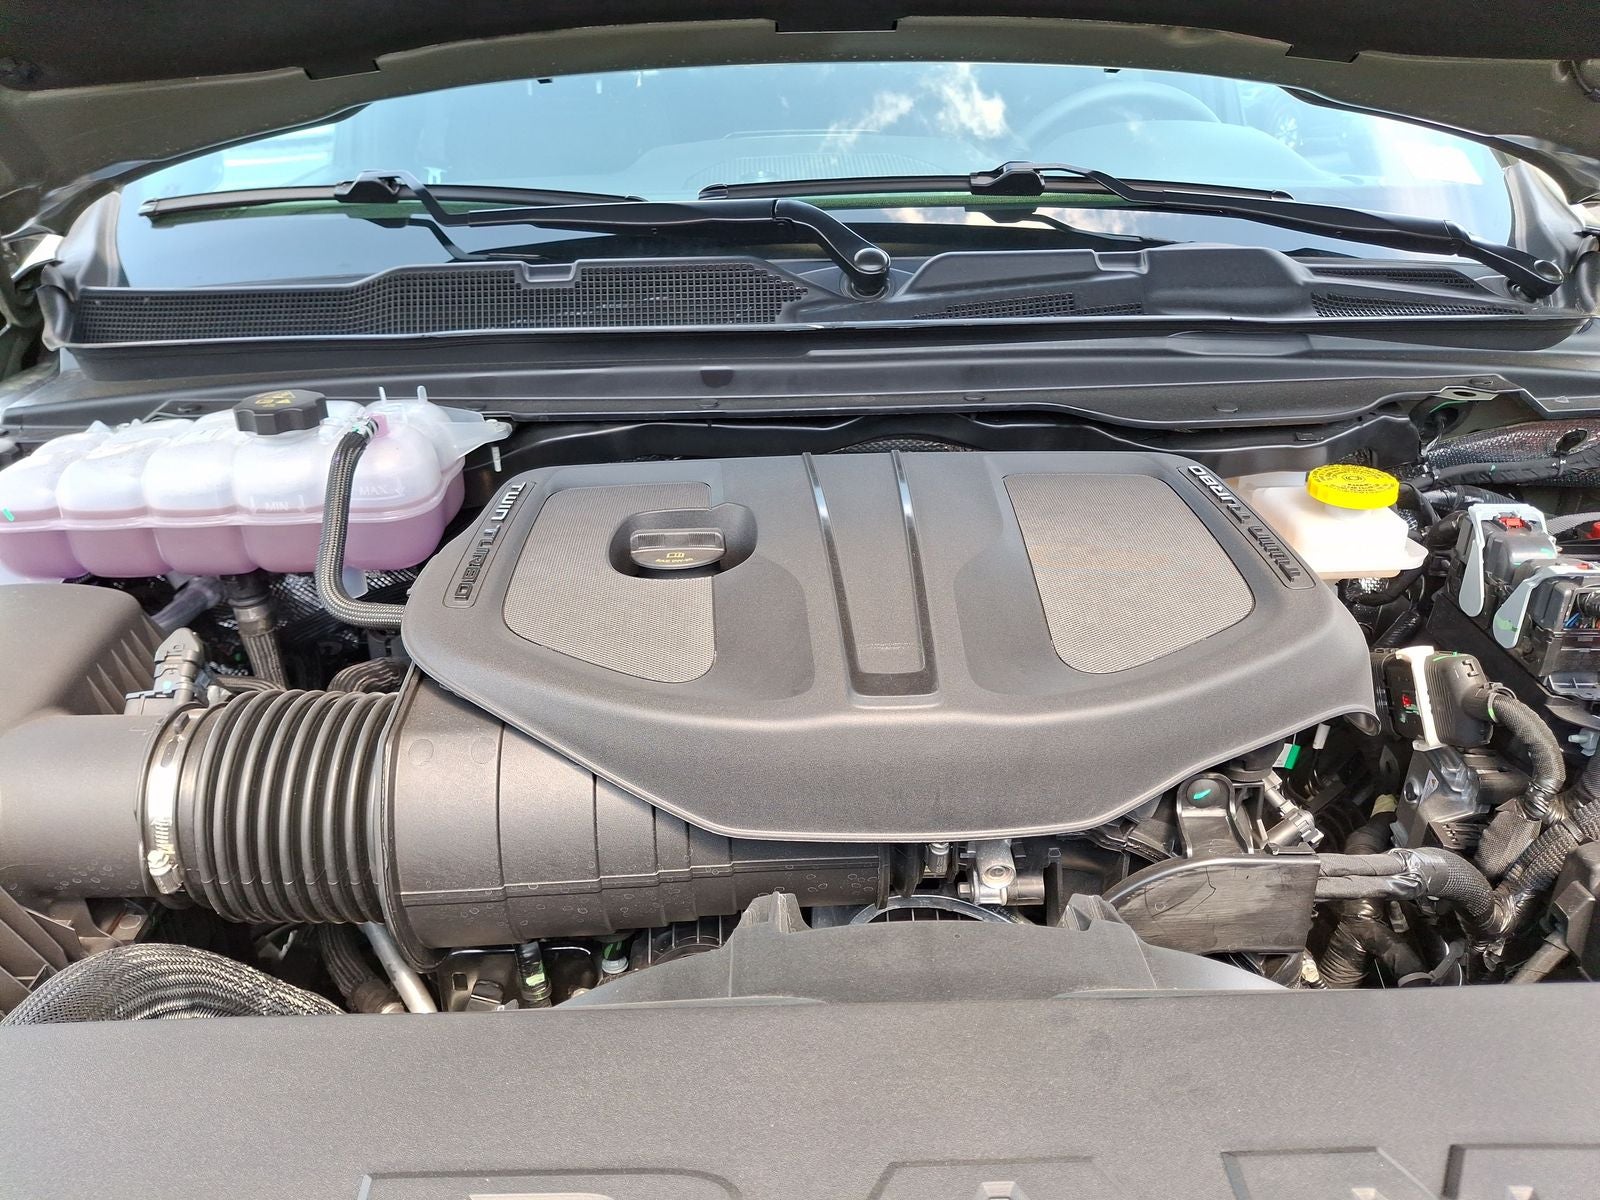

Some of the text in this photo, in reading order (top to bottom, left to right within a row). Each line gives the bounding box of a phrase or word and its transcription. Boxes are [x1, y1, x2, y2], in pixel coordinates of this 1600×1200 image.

[265, 501, 289, 511] MIN
[359, 486, 389, 496] MAX
[1186, 464, 1301, 582] TWIN TURBO
[454, 481, 527, 600] TWIN TURBO
